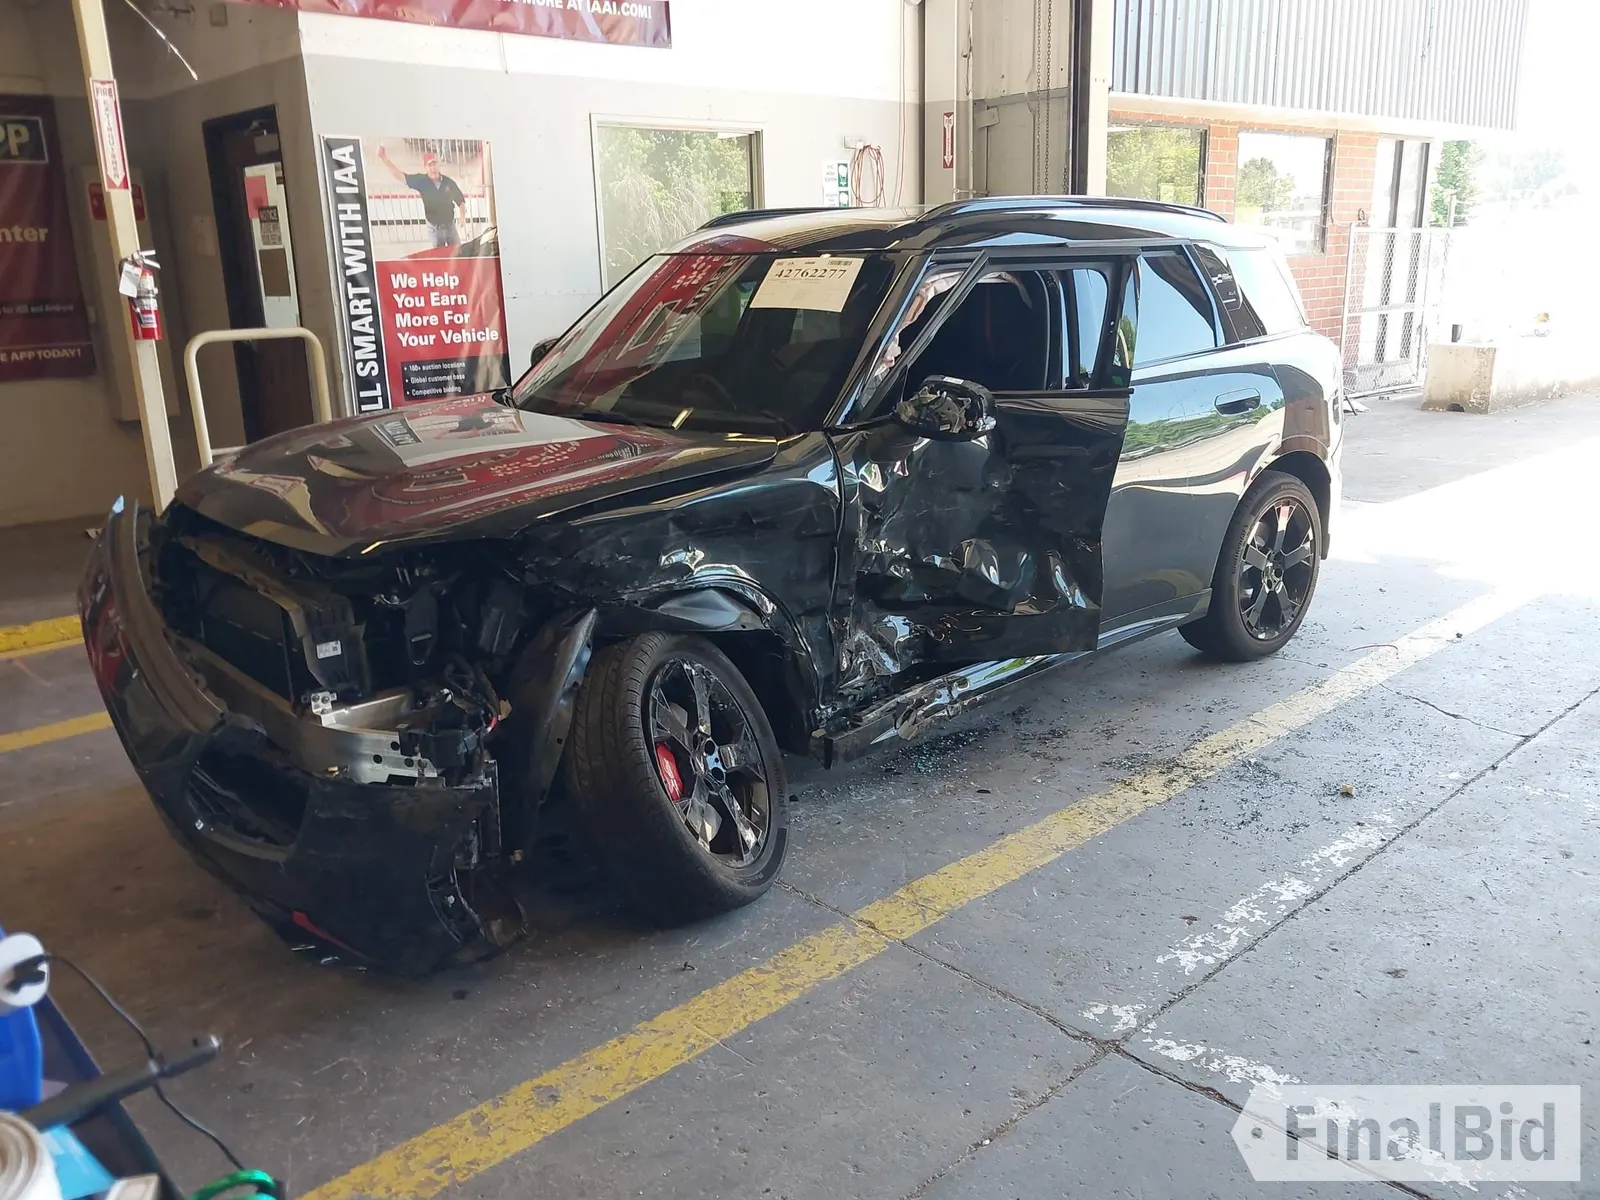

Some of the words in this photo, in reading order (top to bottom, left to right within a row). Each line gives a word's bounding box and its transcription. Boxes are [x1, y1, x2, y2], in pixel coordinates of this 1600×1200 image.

[566, 0, 584, 11] AT
[587, 0, 652, 19] IAAI.COM!
[95, 87, 113, 97] FIRE
[334, 144, 361, 194] IAA
[337, 202, 368, 276] WITH
[391, 273, 417, 289] We
[422, 272, 459, 289] Help
[775, 268, 847, 279] 42762277
[393, 293, 425, 308] You
[430, 292, 467, 307] Earn
[395, 312, 439, 328] More
[443, 310, 470, 325] For
[347, 282, 379, 381] SMART
[397, 332, 436, 347] Your
[440, 328, 499, 344] Vehicle
[422, 363, 441, 371] auction
[442, 361, 466, 369] locations
[410, 376, 427, 384] Global
[428, 374, 452, 382] customer
[411, 388, 442, 397] Competitive
[443, 386, 461, 394] bidding
